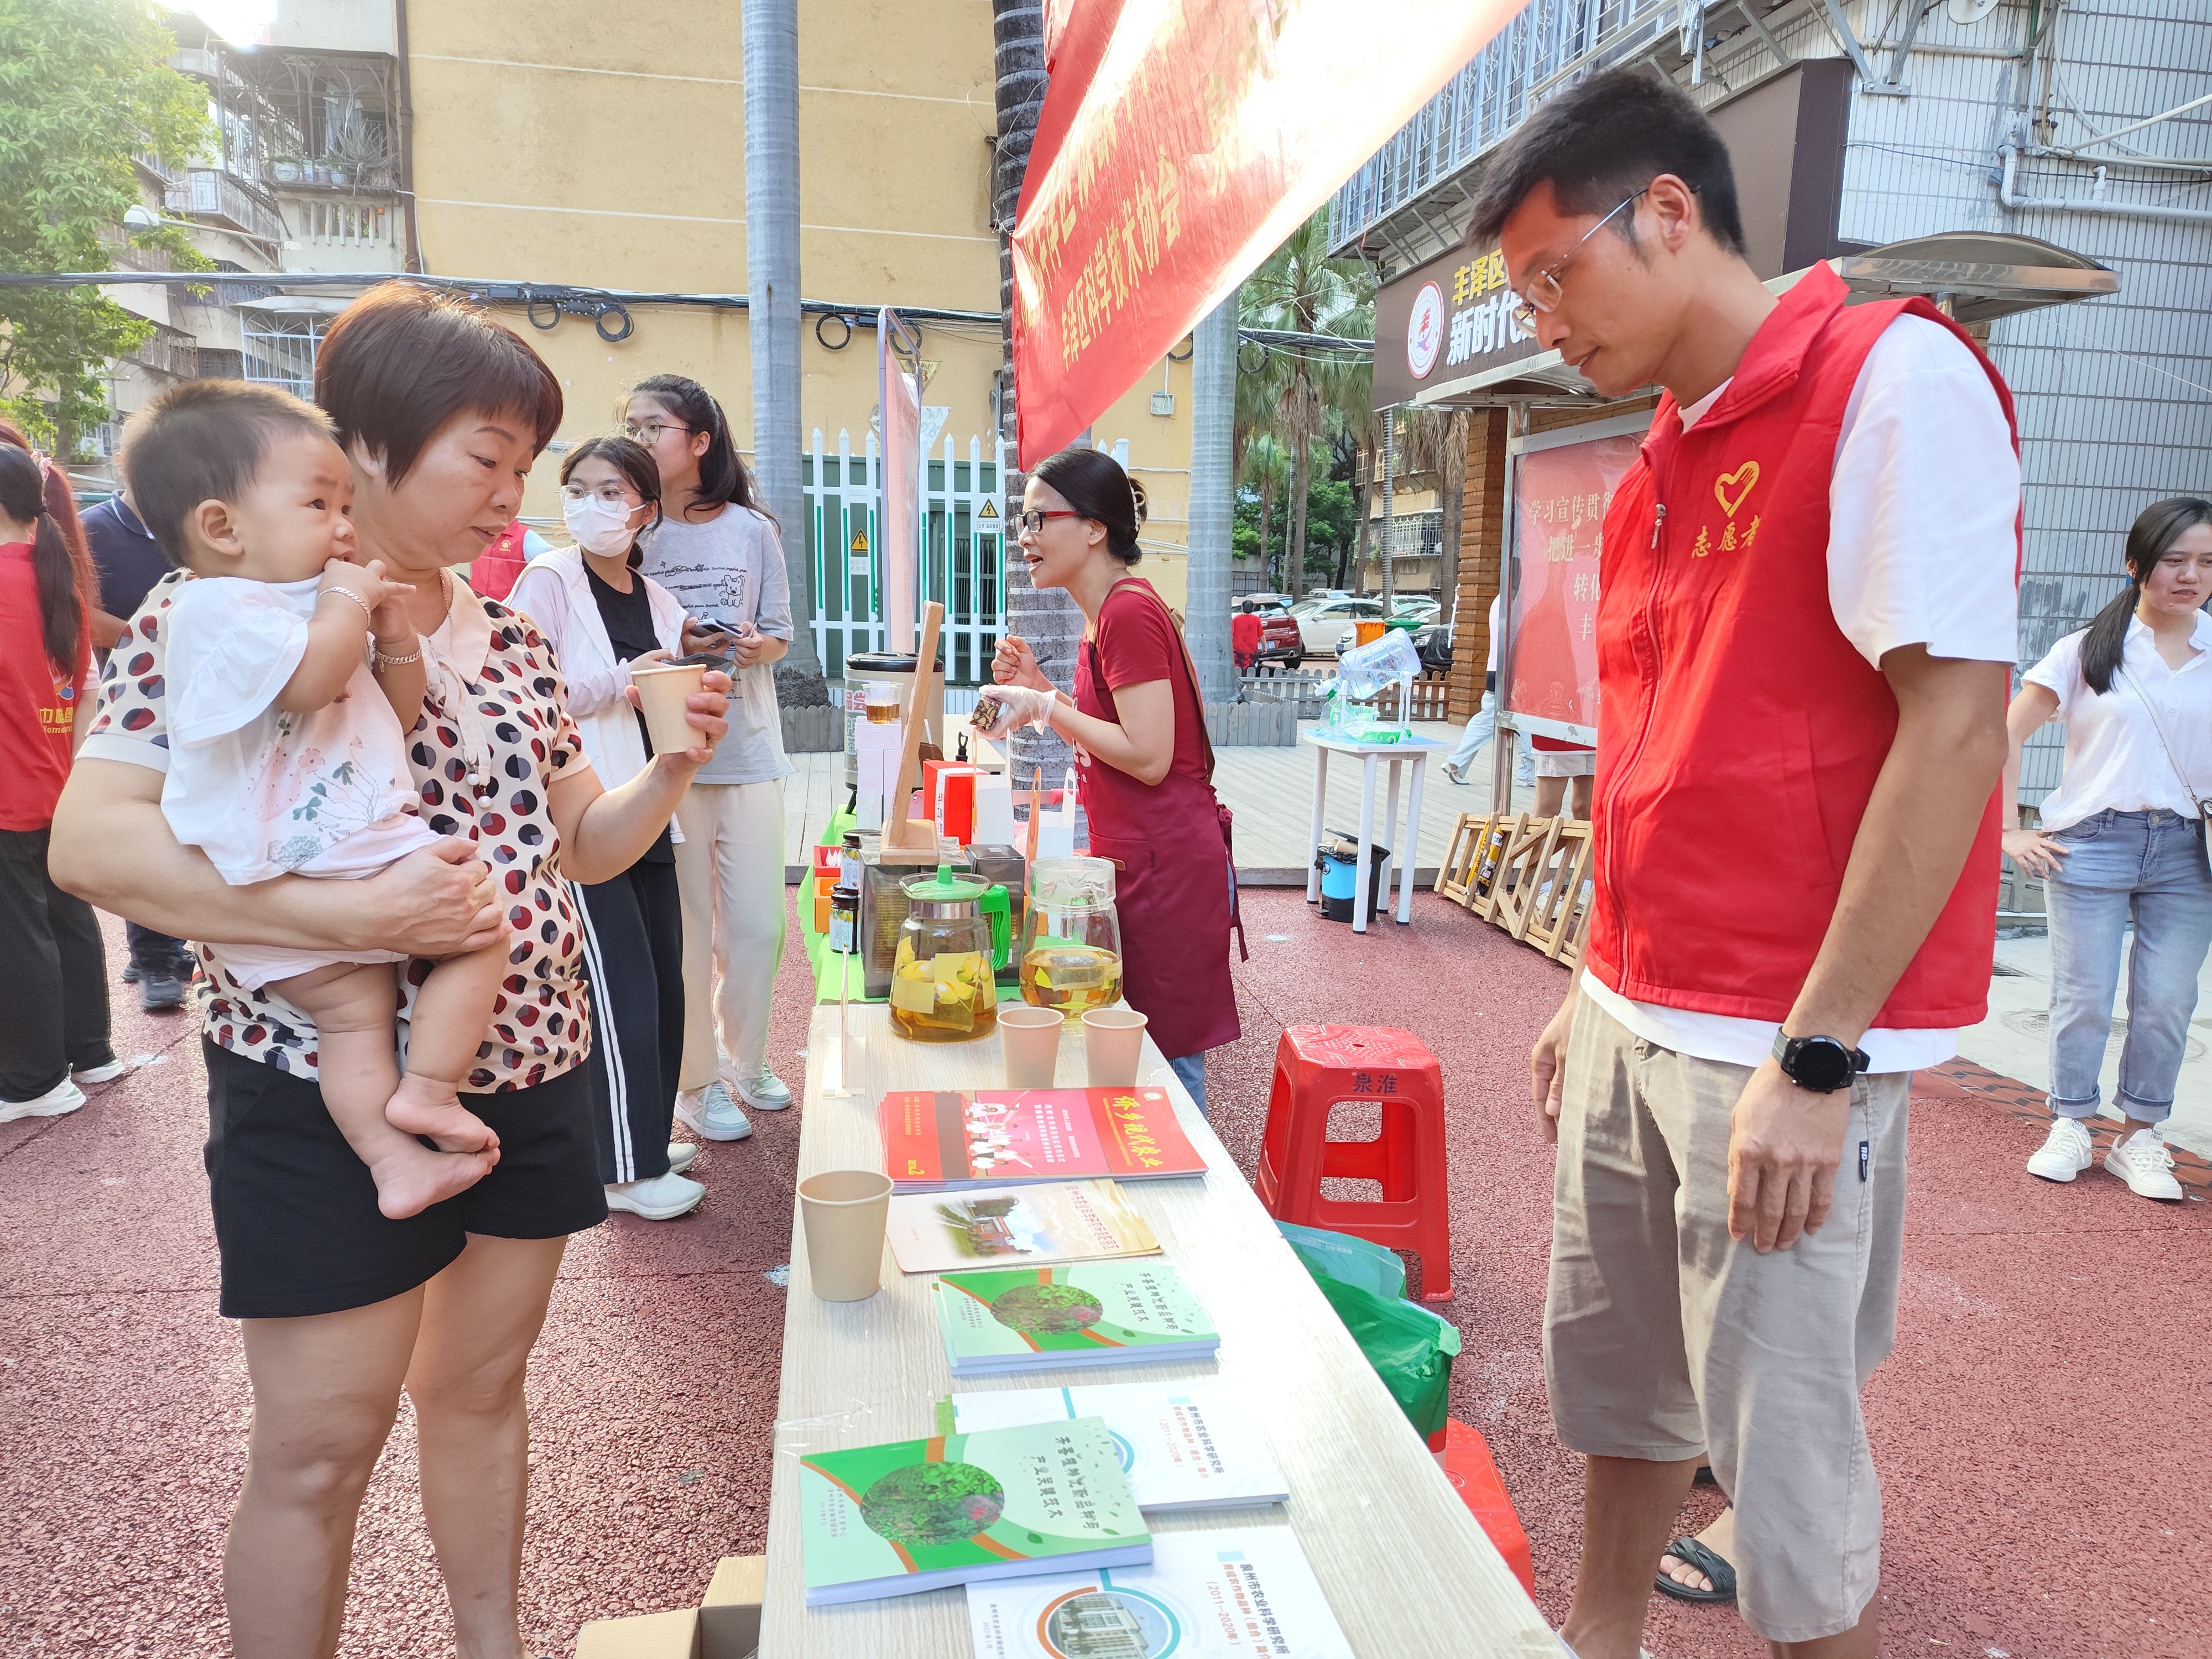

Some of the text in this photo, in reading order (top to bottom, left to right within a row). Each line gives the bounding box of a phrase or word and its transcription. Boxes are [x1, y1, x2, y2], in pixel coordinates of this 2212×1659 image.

[1062, 144, 1181, 372] 丰泽区科学技术协会
[1452, 248, 1511, 306] 丰泽区
[1446, 290, 1529, 366] 新时代
[1548, 532, 1604, 562] 把进一步
[1691, 514, 1762, 559] 志愿者
[1574, 572, 1601, 602] 转化
[1578, 613, 1597, 641] 丰
[1354, 1072, 1398, 1094] 泉淮
[1112, 1095, 1164, 1168] 侨乡现代农业
[1187, 1406, 1225, 1473] 泉州市农业科学研究所
[1030, 1455, 1064, 1519] 产业关键技术
[1054, 1436, 1099, 1529] 芳香植物优新品种与
[989, 1604, 1005, 1659] 泉州市农业科学研究所
[1239, 1563, 1291, 1654] 泉州市农业科学研究所
